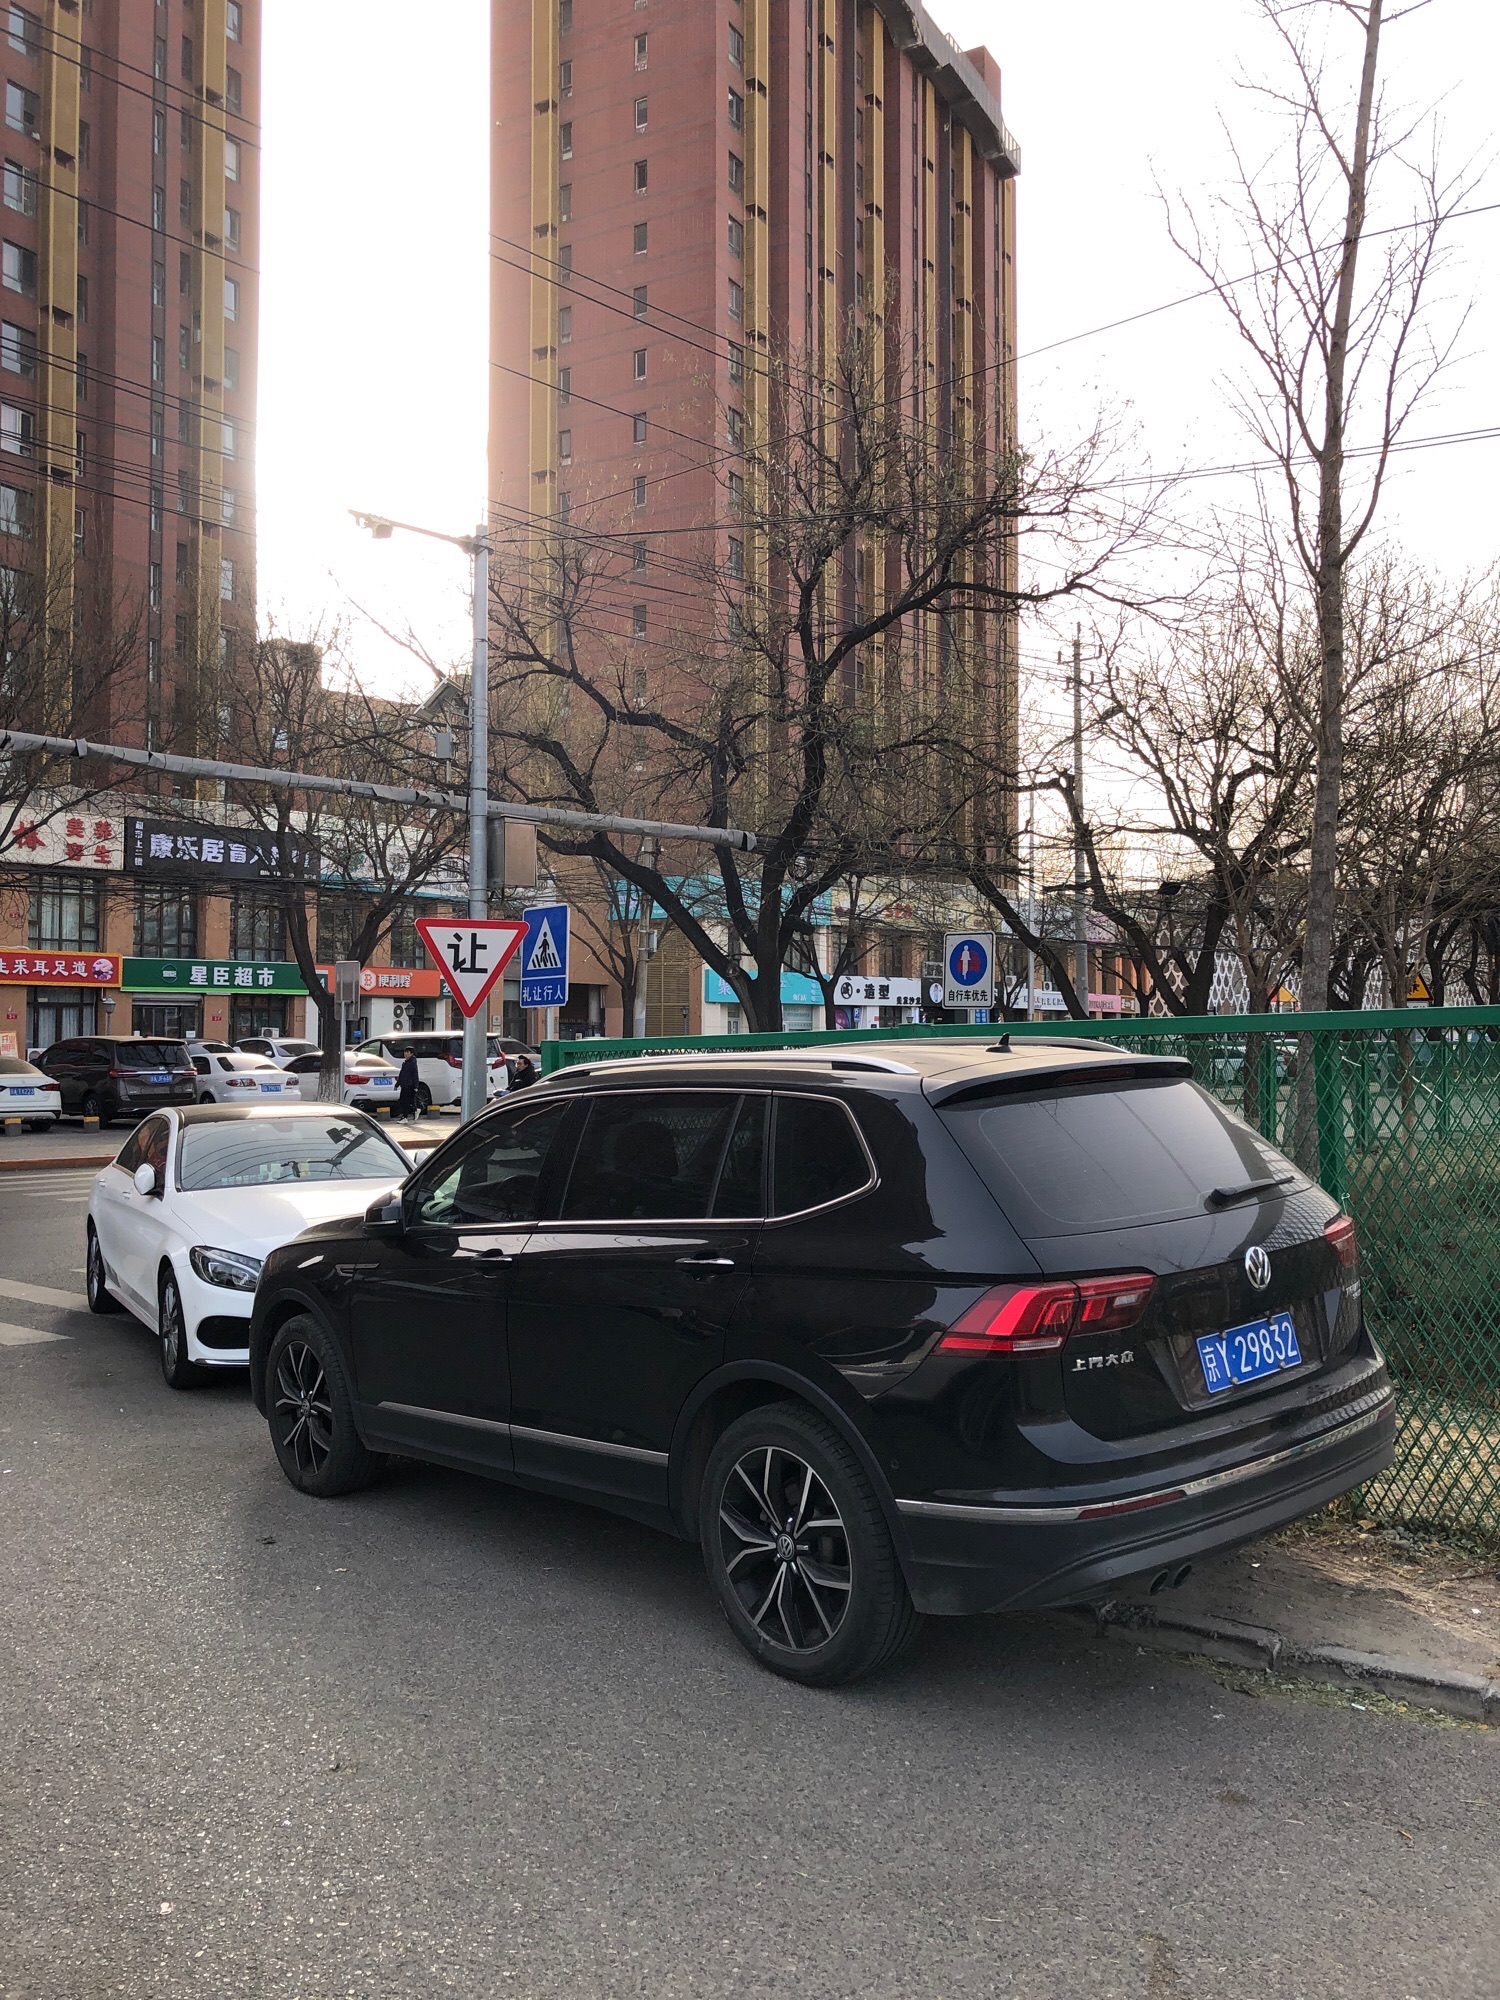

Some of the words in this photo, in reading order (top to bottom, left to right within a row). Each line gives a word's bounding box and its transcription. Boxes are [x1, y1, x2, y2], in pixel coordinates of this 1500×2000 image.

[447, 932, 488, 973] 让
[189, 965, 275, 987] 星臣超市
[378, 973, 411, 988] 便利蜂
[522, 984, 564, 1002] 礼让行人
[863, 983, 890, 1000] 造型
[948, 989, 988, 1002] 自行车优先
[1071, 1351, 1134, 1372] 上汽大众
